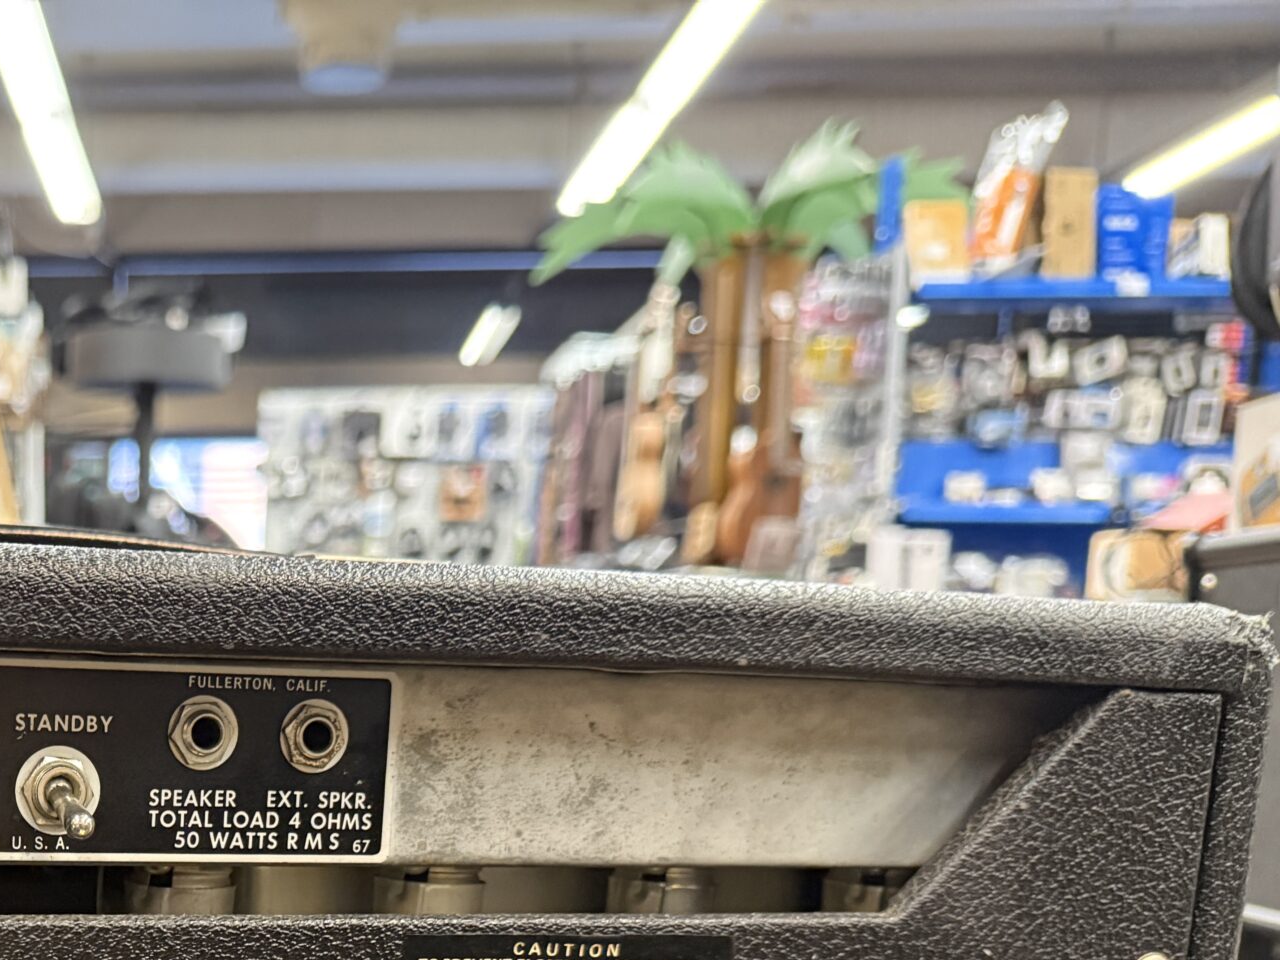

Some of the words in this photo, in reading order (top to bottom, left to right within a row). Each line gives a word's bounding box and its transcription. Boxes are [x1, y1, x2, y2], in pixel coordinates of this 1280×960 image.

[188, 675, 276, 691] FULLERTON,
[286, 678, 331, 693] CALIF.
[15, 713, 113, 732] STANDBY
[148, 789, 236, 807] SPEAKER
[267, 790, 308, 808] EXT.
[318, 792, 372, 810] SPKR.
[148, 810, 213, 828] TOTAL
[223, 811, 279, 829] LOAD
[289, 812, 301, 829] 4
[310, 813, 372, 831] OHMS
[174, 831, 200, 848] 50
[209, 832, 278, 849] WATTS
[352, 839, 371, 853] 67
[513, 942, 621, 957] CAUTION
